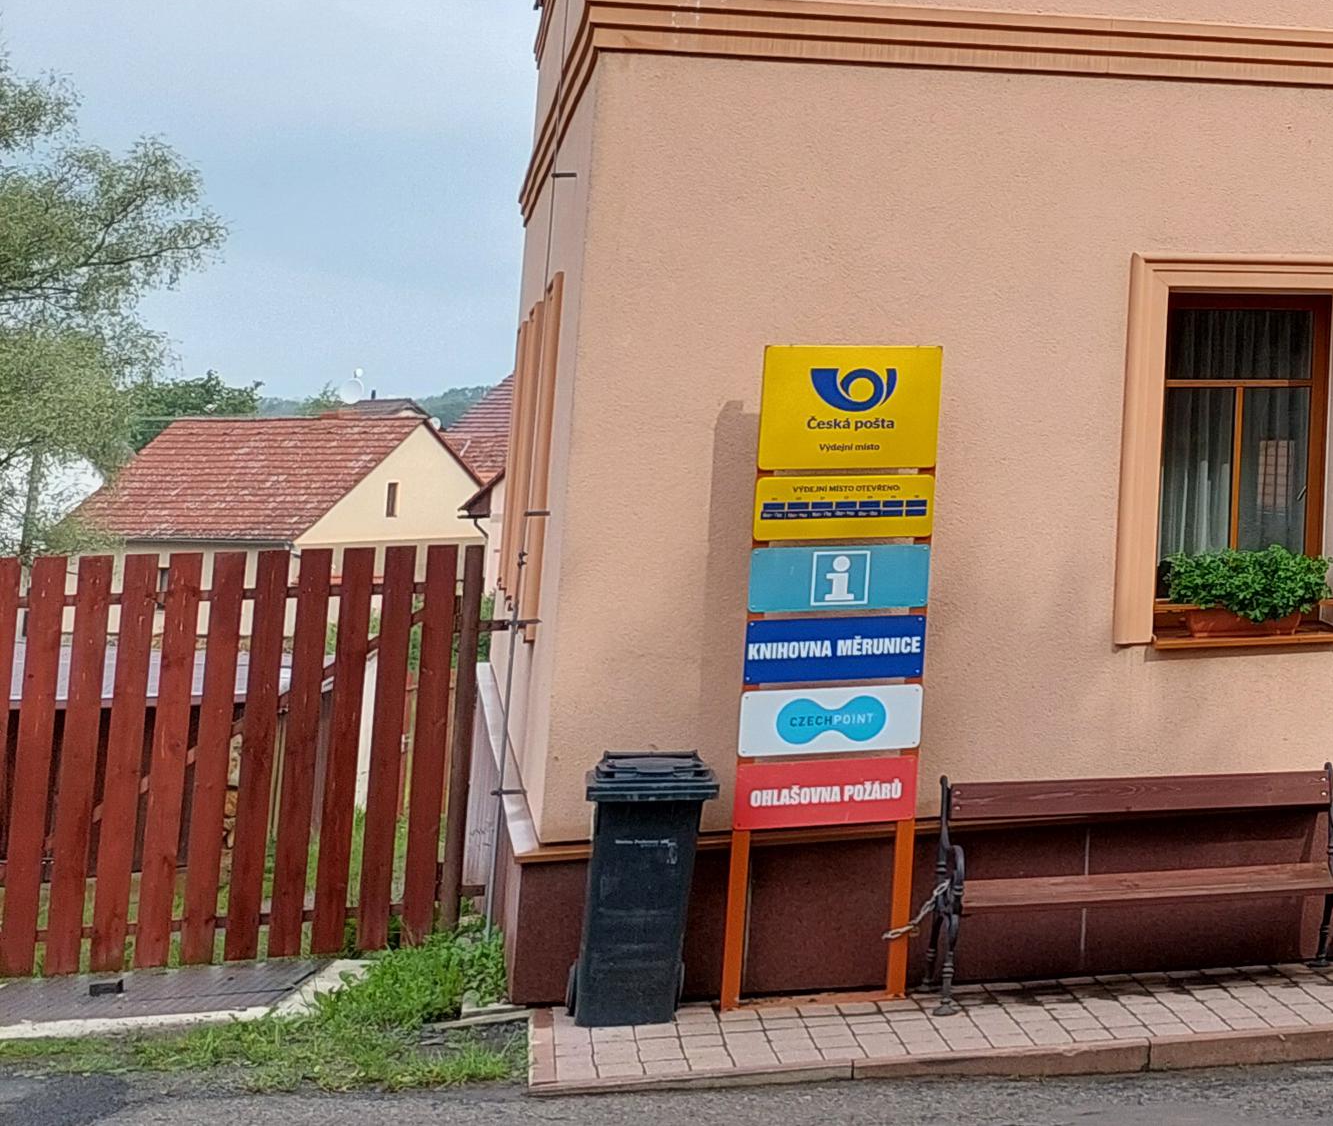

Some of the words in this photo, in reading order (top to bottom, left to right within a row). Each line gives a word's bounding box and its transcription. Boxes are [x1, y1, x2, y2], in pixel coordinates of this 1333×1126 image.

[806, 416, 851, 430] Česká
[854, 417, 895, 431] pošta
[819, 443, 853, 452] Výdejní
[855, 443, 880, 451] místo
[792, 485, 828, 493] VÝDEJNÍ
[747, 640, 832, 661] KNIHOVNA
[836, 635, 922, 657] MĚRUNICE
[750, 785, 842, 807] OHLAŠOVNA
[843, 778, 902, 802] POŽÁRŮ
